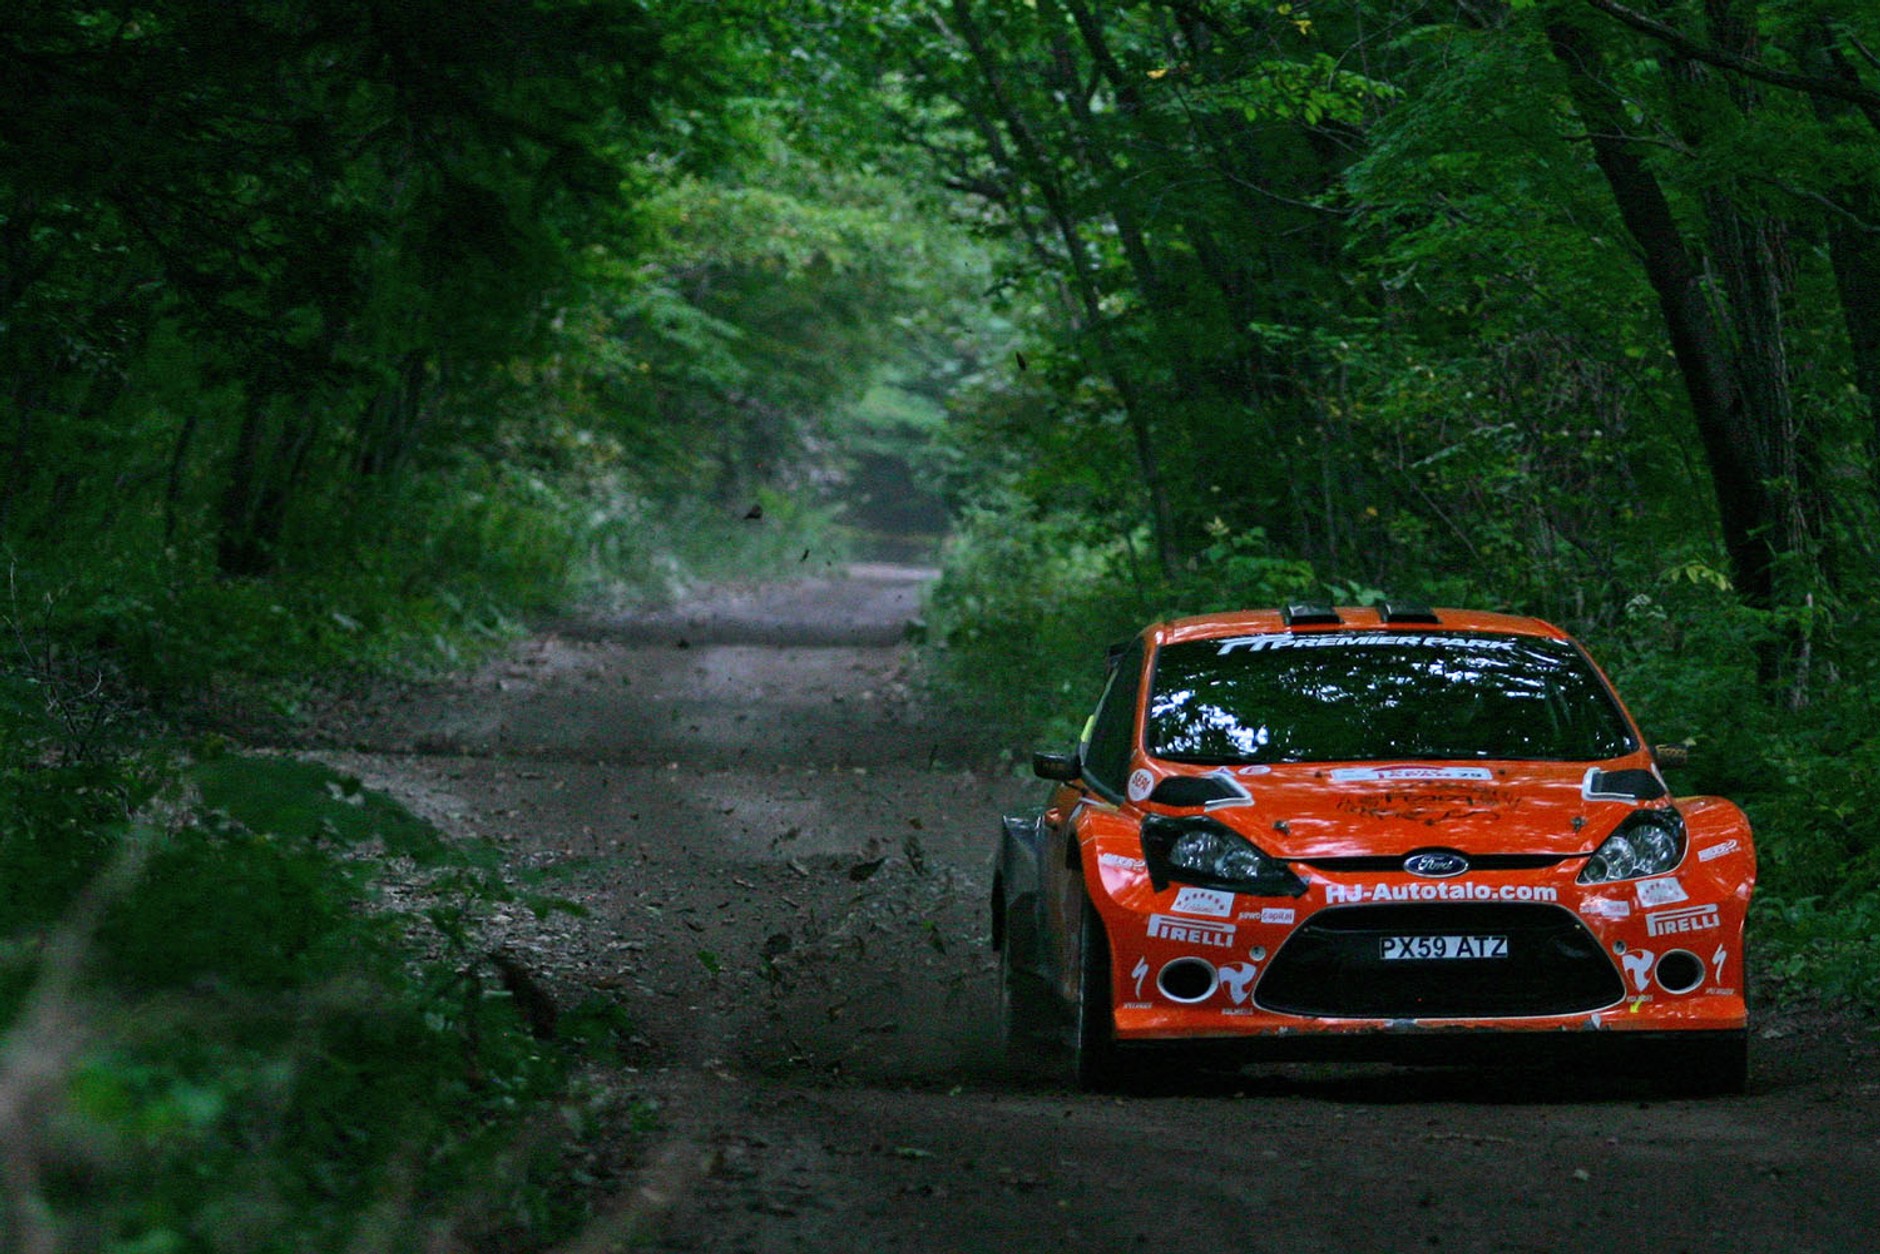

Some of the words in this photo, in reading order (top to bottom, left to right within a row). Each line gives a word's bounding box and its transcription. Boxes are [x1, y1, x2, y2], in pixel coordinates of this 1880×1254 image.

[1423, 636, 1515, 650] PARK
[1417, 855, 1454, 871] Ford
[1325, 882, 1557, 904] HJ-Autotalo.com
[1147, 913, 1236, 948] PIRELLI
[1645, 903, 1721, 937] PIRELLI
[1381, 937, 1446, 958] PX59
[1455, 936, 1507, 958] ATZ
